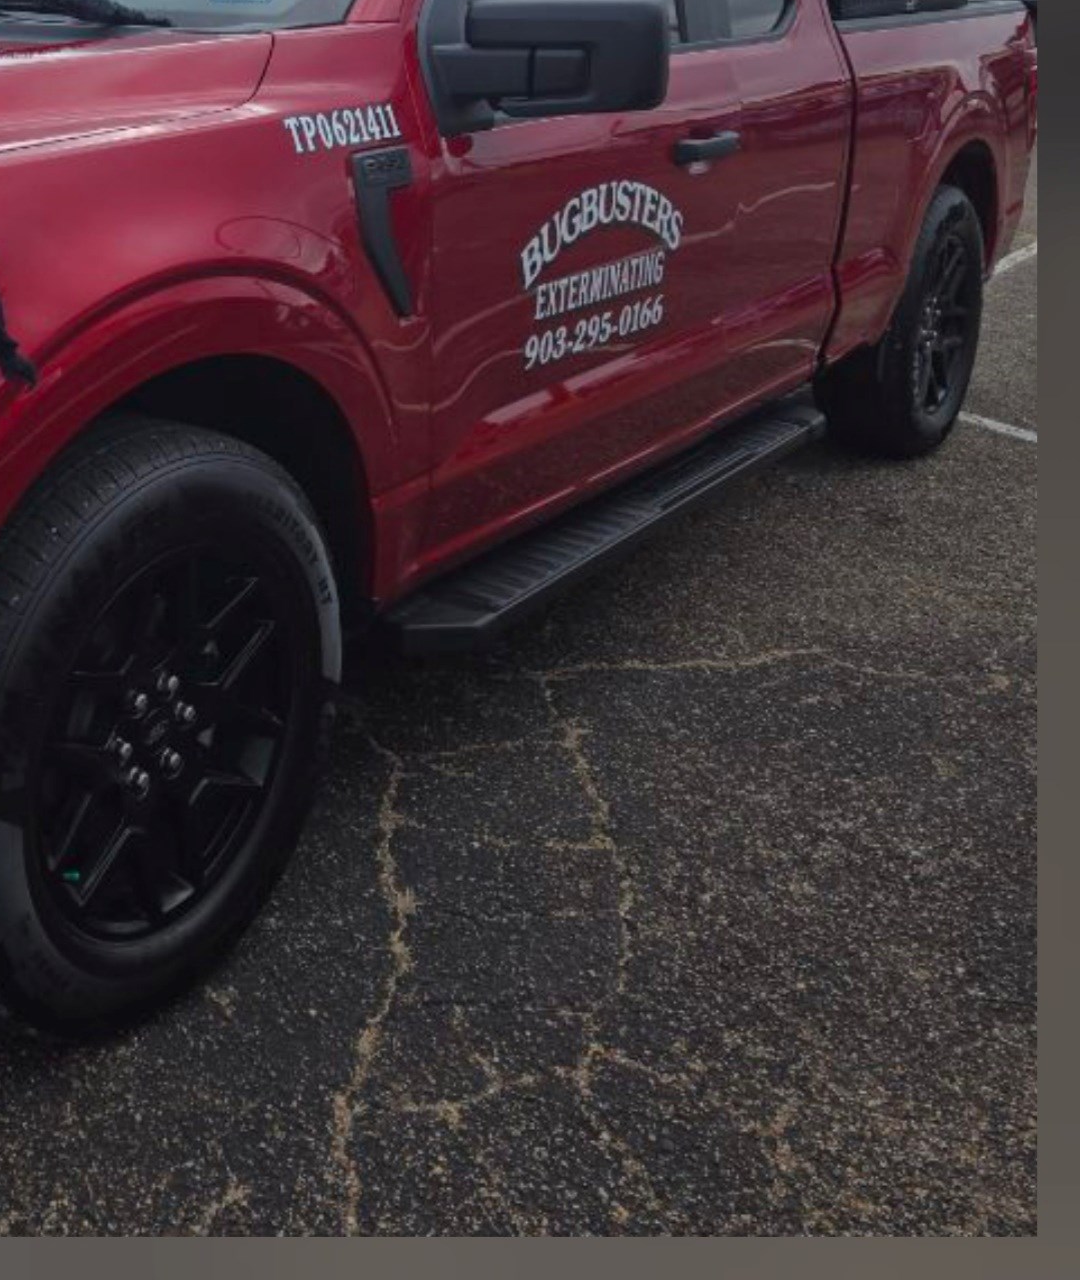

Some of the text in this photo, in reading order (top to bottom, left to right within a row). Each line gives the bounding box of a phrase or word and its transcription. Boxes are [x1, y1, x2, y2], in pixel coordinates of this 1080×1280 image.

[283, 103, 402, 154] TP0621411
[520, 180, 684, 290] BUGBUSTERS
[533, 251, 666, 320] EXTERMINATING
[524, 294, 665, 371] 903-295-0166
